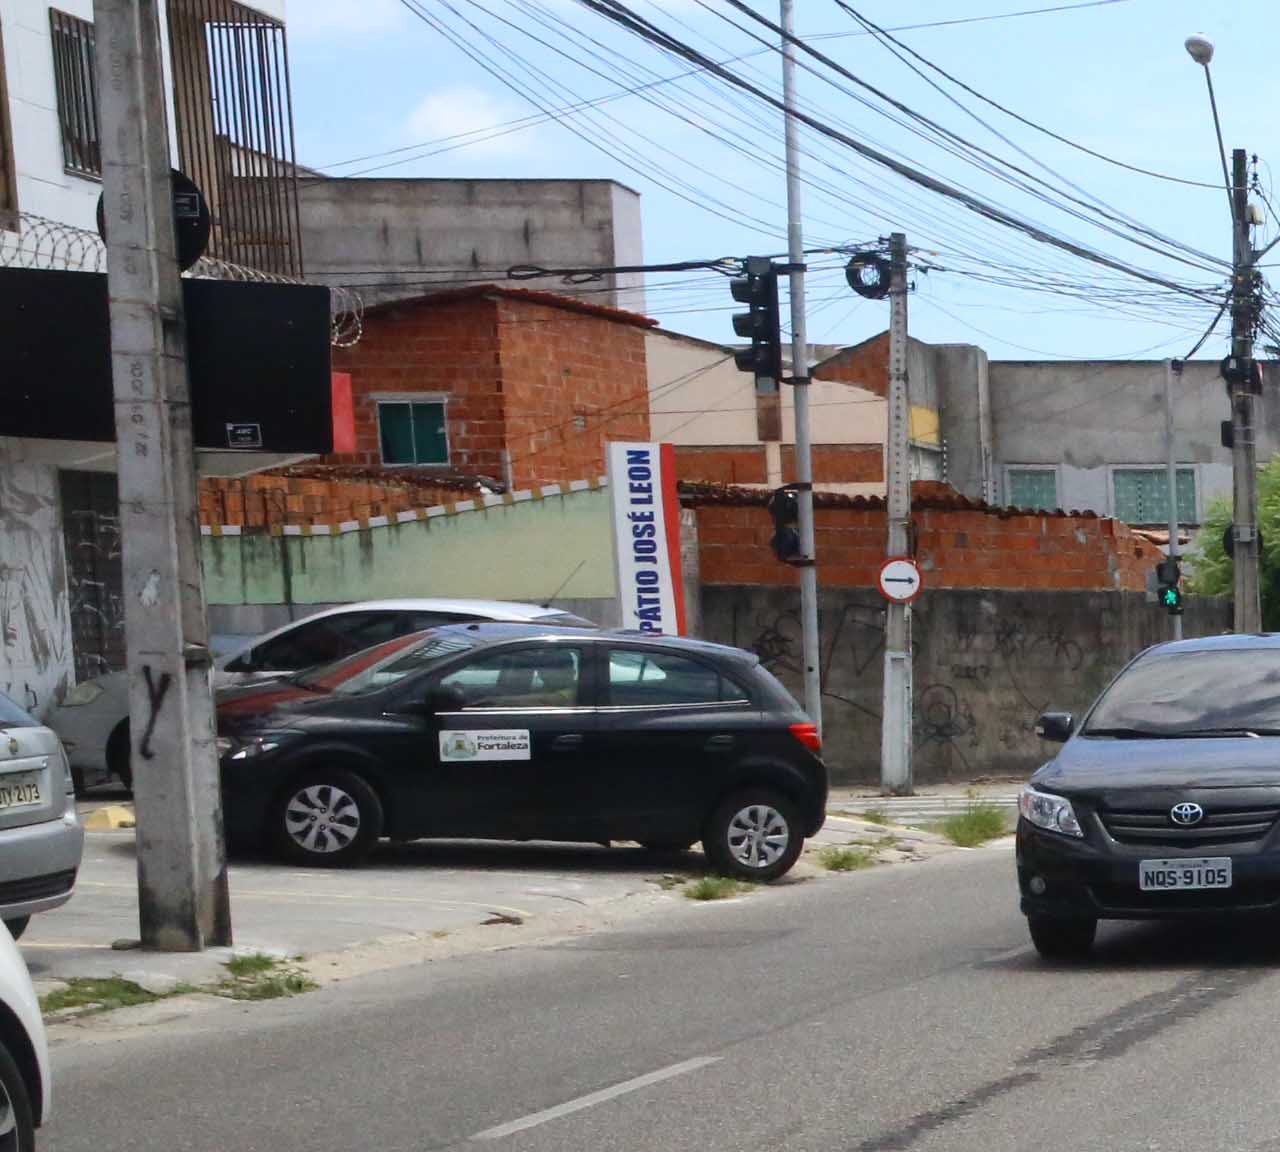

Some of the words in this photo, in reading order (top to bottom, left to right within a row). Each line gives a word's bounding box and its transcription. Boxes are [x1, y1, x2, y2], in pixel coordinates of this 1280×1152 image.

[627, 450, 654, 505] LEON
[627, 511, 657, 564] JOSÉ
[634, 570, 662, 634] PÁTIO
[477, 742, 529, 750] Fortaleza
